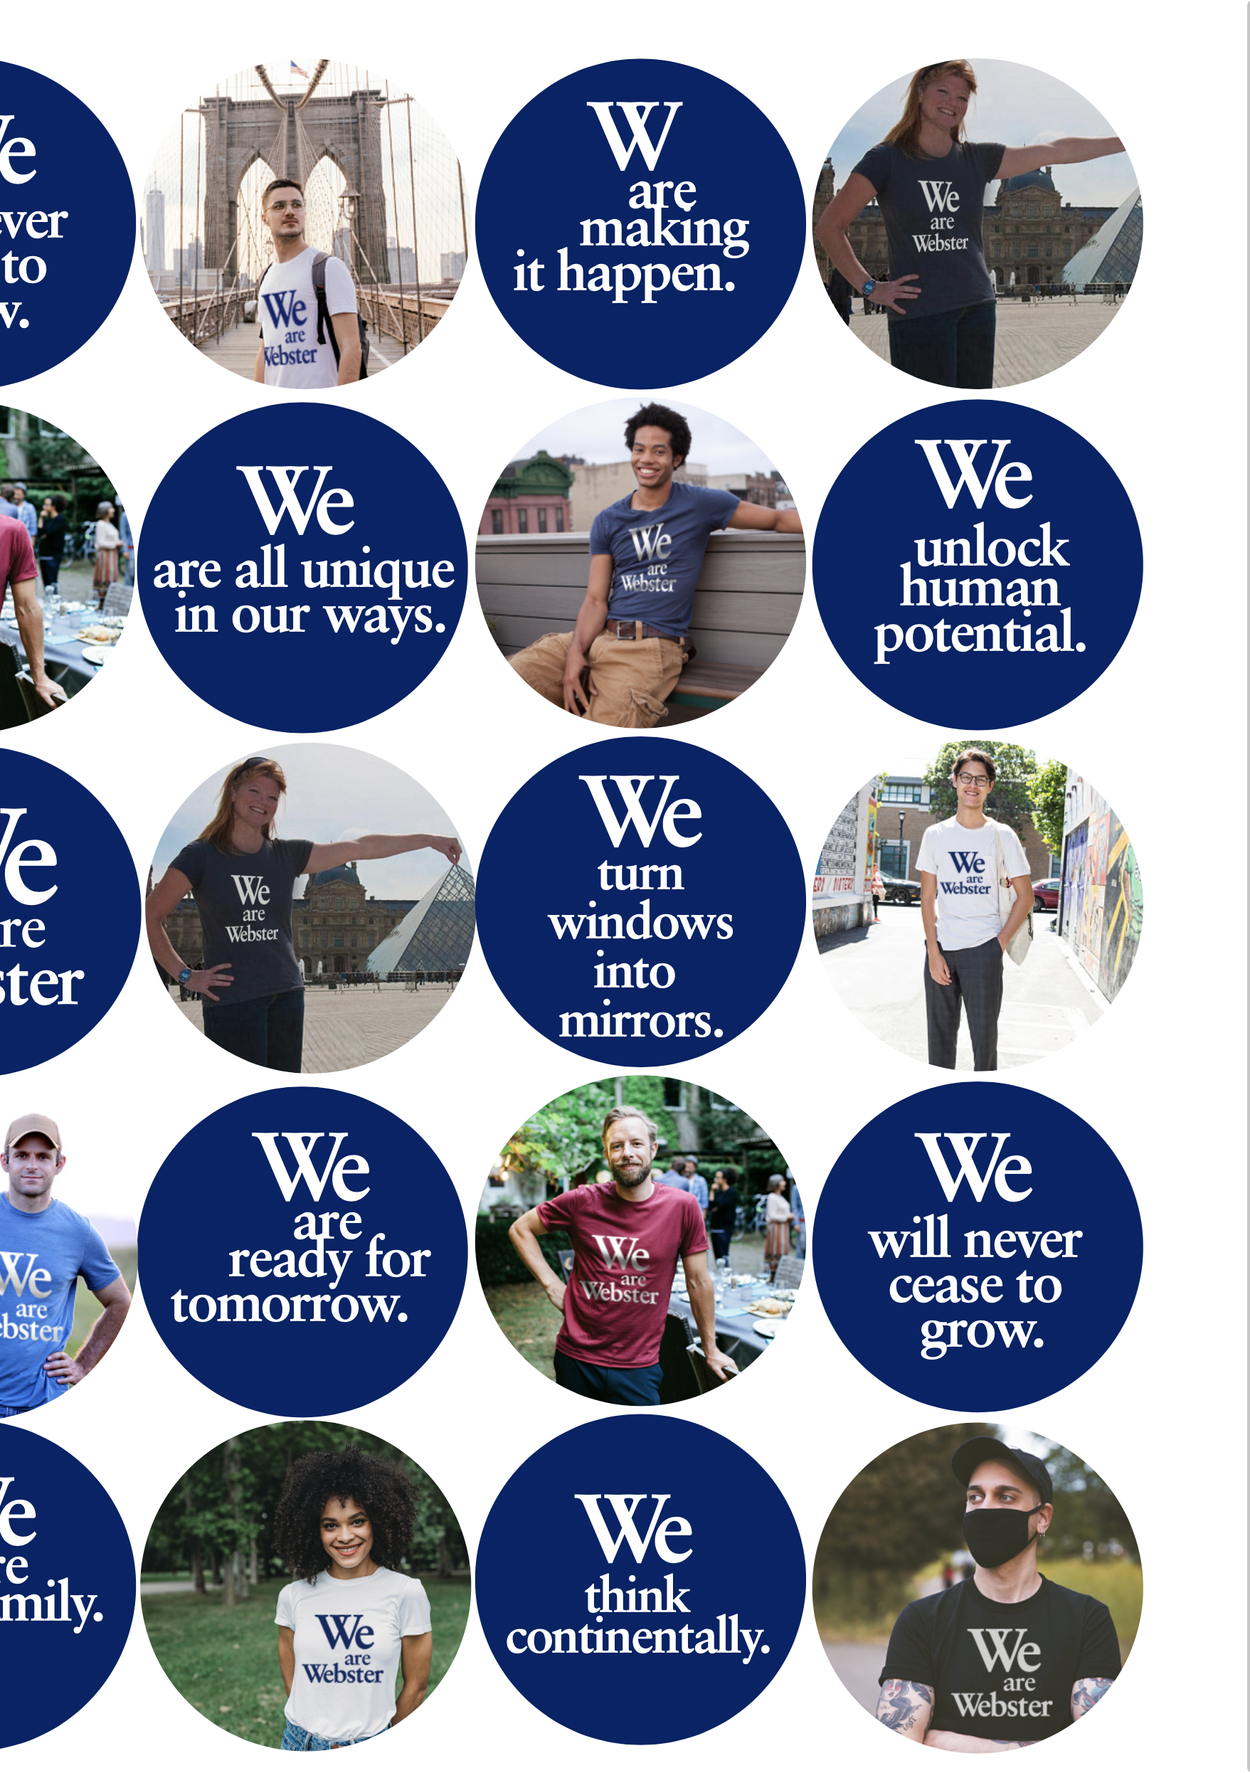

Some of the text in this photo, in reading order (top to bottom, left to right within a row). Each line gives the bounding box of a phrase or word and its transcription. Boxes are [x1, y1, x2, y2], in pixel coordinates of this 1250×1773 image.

[587, 102, 683, 171] W
[629, 181, 696, 209] are
[918, 180, 960, 213] We
[580, 203, 749, 258] making
[930, 216, 955, 231] are
[912, 233, 969, 253] Webster
[1, 251, 46, 283] to
[514, 247, 735, 303] it happen.
[261, 290, 308, 329] We
[285, 330, 306, 344] are
[915, 440, 1033, 509] We
[236, 466, 354, 535] We
[628, 523, 672, 563] We
[914, 522, 1070, 567] unlock
[154, 544, 454, 600] are all unique
[621, 573, 677, 594] Webster
[648, 563, 667, 576] are
[900, 561, 1061, 606] human
[175, 591, 445, 645] in our ways.
[874, 607, 1086, 664] potential.
[579, 775, 702, 848] We
[598, 860, 684, 890] turn
[948, 852, 985, 874] We
[967, 876, 983, 884] are
[231, 874, 270, 905] We
[940, 882, 991, 895] Webster
[242, 908, 266, 922] are
[547, 899, 733, 939] windows
[226, 924, 279, 944] Webster
[594, 950, 675, 988] into
[559, 999, 723, 1037] mirrors.
[252, 1133, 370, 1202] We
[914, 1133, 1032, 1202] We
[294, 1212, 362, 1240] are
[868, 1214, 1083, 1258] will never
[229, 1233, 431, 1289] ready for
[592, 1235, 650, 1271] We
[579, 1280, 659, 1305] Webster
[621, 1273, 646, 1287] are
[890, 1270, 1062, 1303] cease to
[16, 1301, 47, 1319] are
[171, 1289, 407, 1322] tomorrow.
[921, 1320, 1043, 1360] grow.
[574, 1494, 692, 1563] We
[585, 1573, 691, 1613] think
[315, 1614, 374, 1650] We
[507, 1614, 770, 1664] continentally.
[345, 1652, 370, 1666] are
[967, 1628, 1041, 1673] We
[302, 1663, 384, 1684] Webster
[1004, 1675, 1036, 1692] are
[951, 1691, 1053, 1718] Webster
